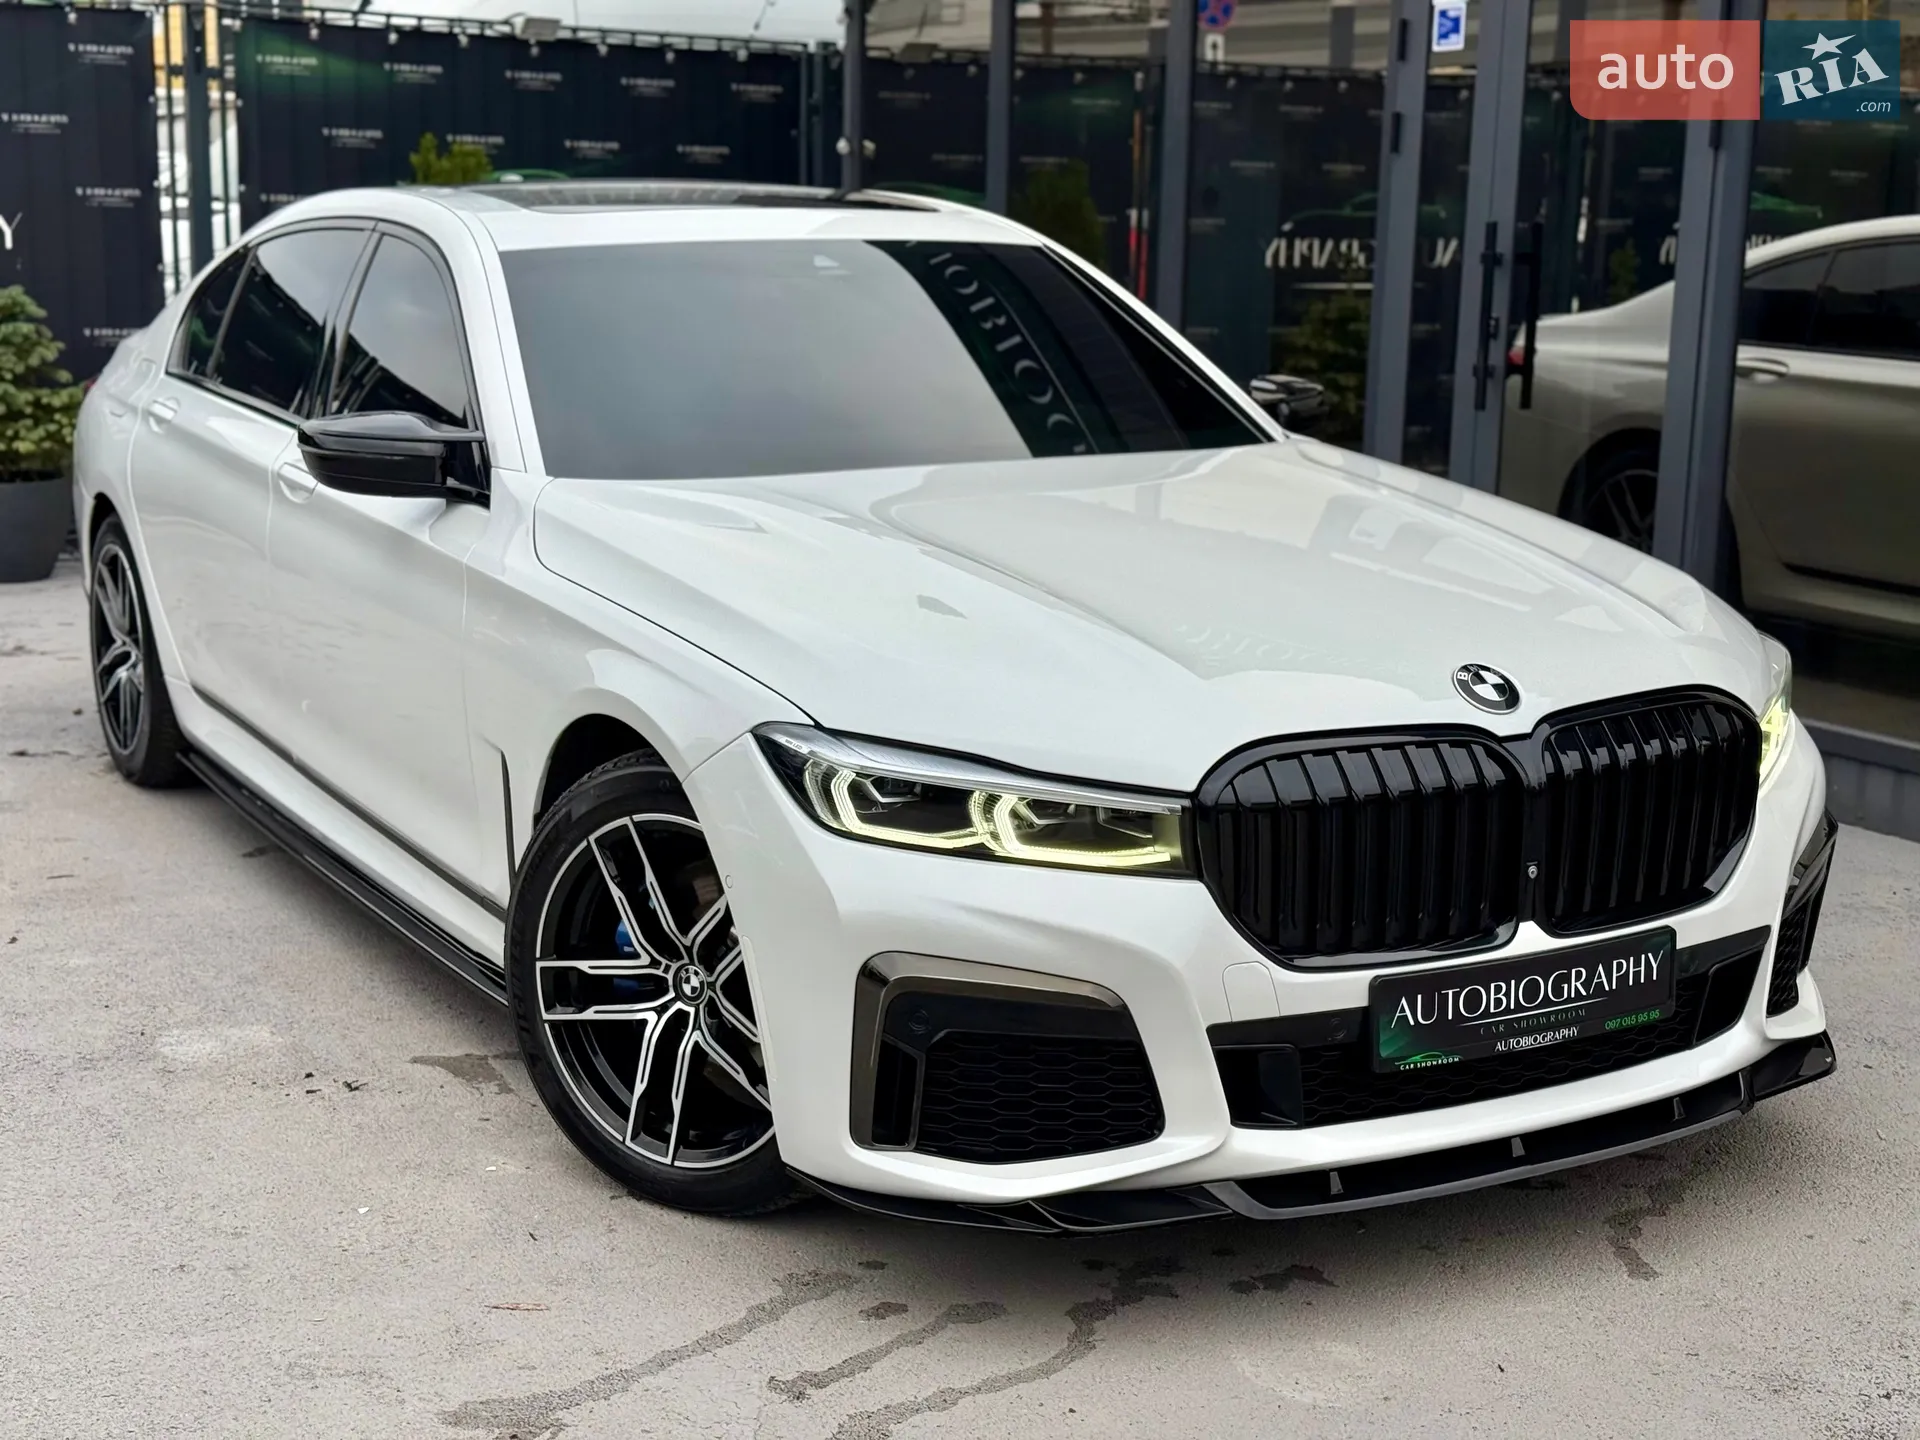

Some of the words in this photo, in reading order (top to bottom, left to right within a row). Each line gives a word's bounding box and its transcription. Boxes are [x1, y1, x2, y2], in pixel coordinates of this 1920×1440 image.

[1391, 950, 1664, 1029] AUTOBIOGRAPHY
[1513, 1008, 1586, 1029] SHOWROOM
[1605, 1019, 1621, 1030] 097
[1622, 1015, 1636, 1026] 015
[1494, 1026, 1580, 1052] AUTOBIOGRAPHY
[1400, 1063, 1415, 1071] CAR
[1417, 1057, 1460, 1069] SHOWROOM
